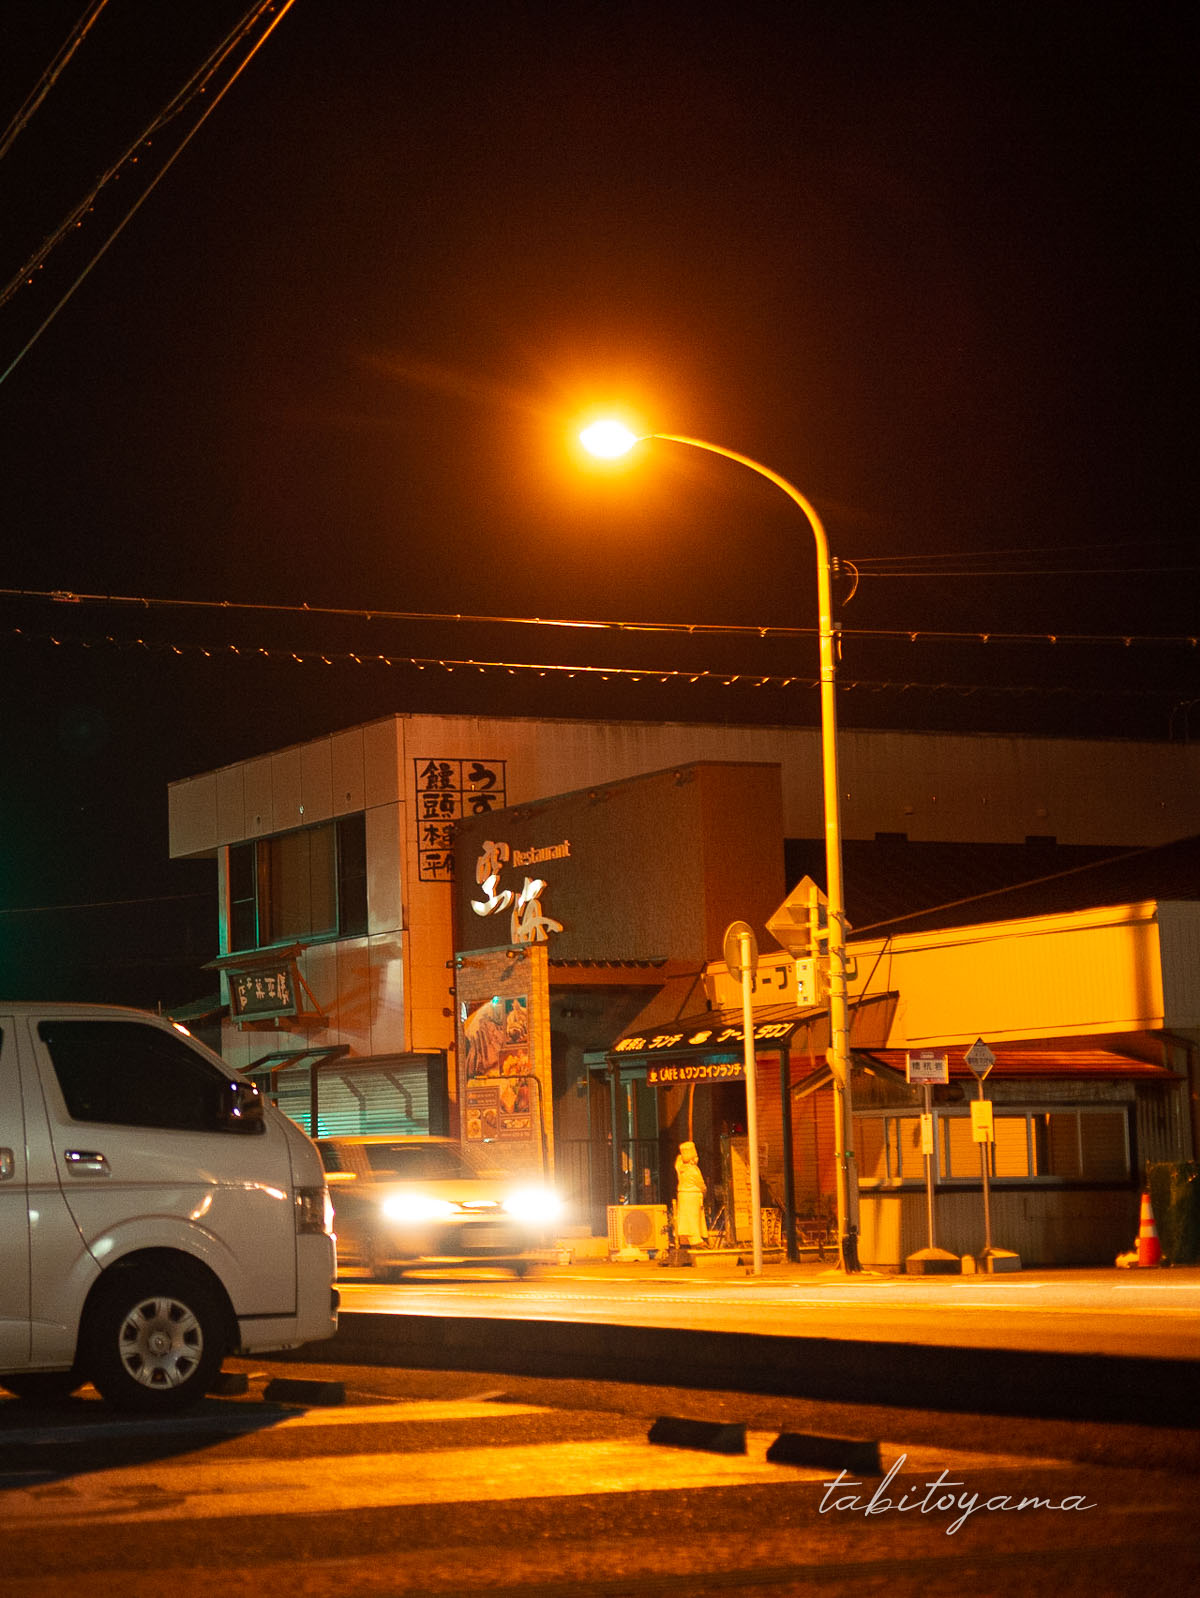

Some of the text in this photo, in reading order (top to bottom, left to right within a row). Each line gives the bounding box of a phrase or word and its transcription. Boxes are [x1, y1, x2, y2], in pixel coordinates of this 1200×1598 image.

[512, 839, 571, 869] Restaurant
[648, 1033, 684, 1049] ランチ
